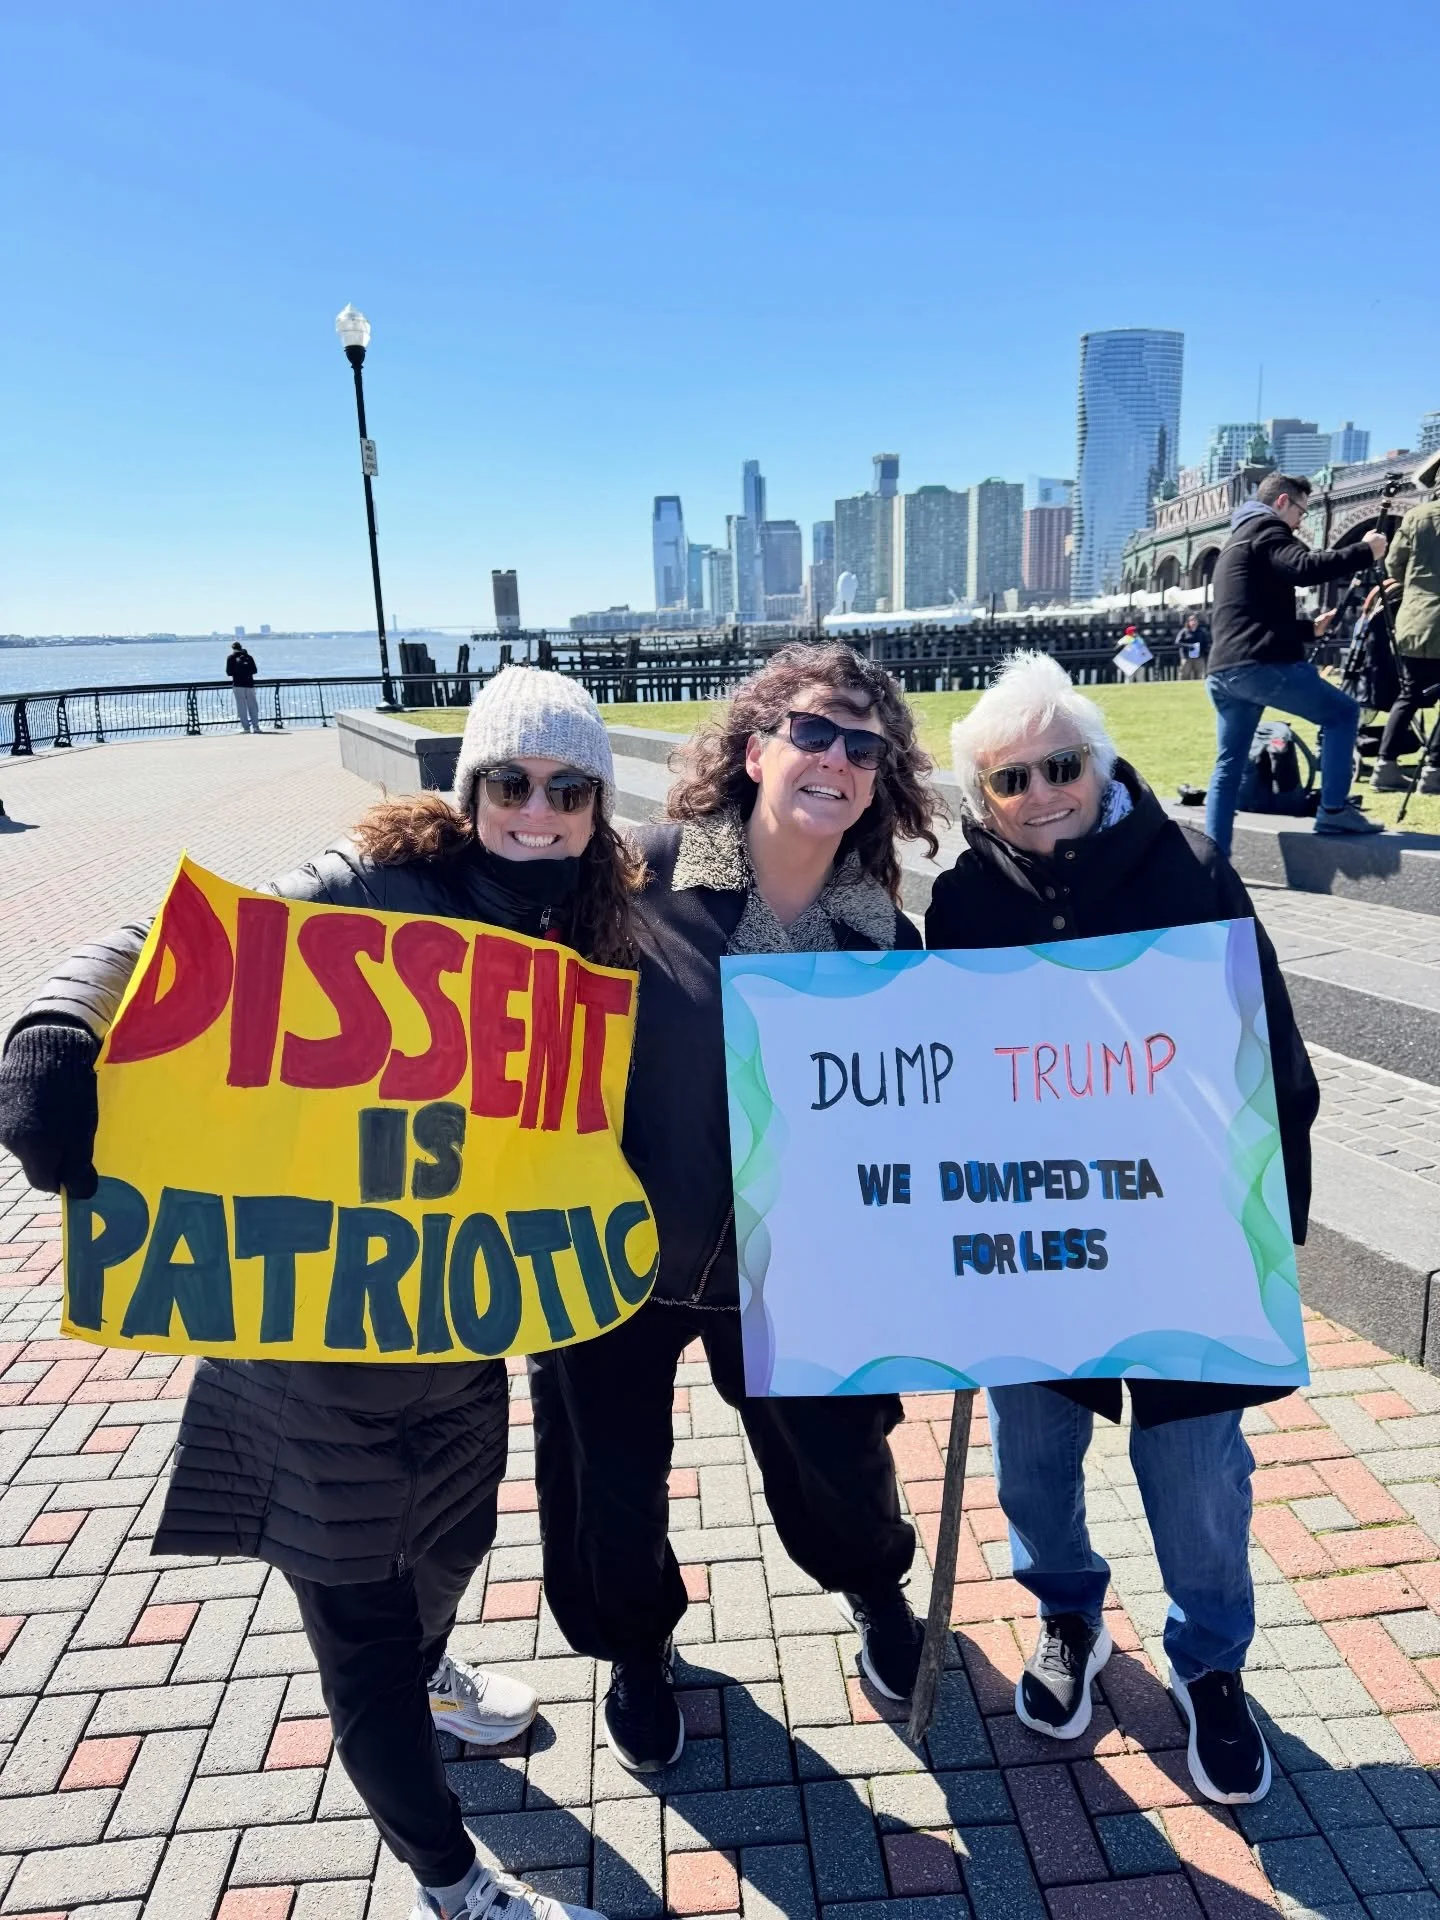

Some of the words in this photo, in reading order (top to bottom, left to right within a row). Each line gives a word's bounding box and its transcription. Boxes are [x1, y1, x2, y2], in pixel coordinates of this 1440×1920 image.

[104, 867, 633, 1134] DISSENT
[810, 1042, 954, 1110] DUMP
[994, 1032, 1177, 1103] TRUMP
[358, 1101, 467, 1204] IS
[857, 1163, 912, 1206] WE
[939, 1159, 1090, 1204] DUMPED
[1090, 1158, 1164, 1202] TEA
[67, 1175, 660, 1356] PATRIOTIC
[953, 1232, 1018, 1276] FOR
[1020, 1229, 1109, 1273] LESS
